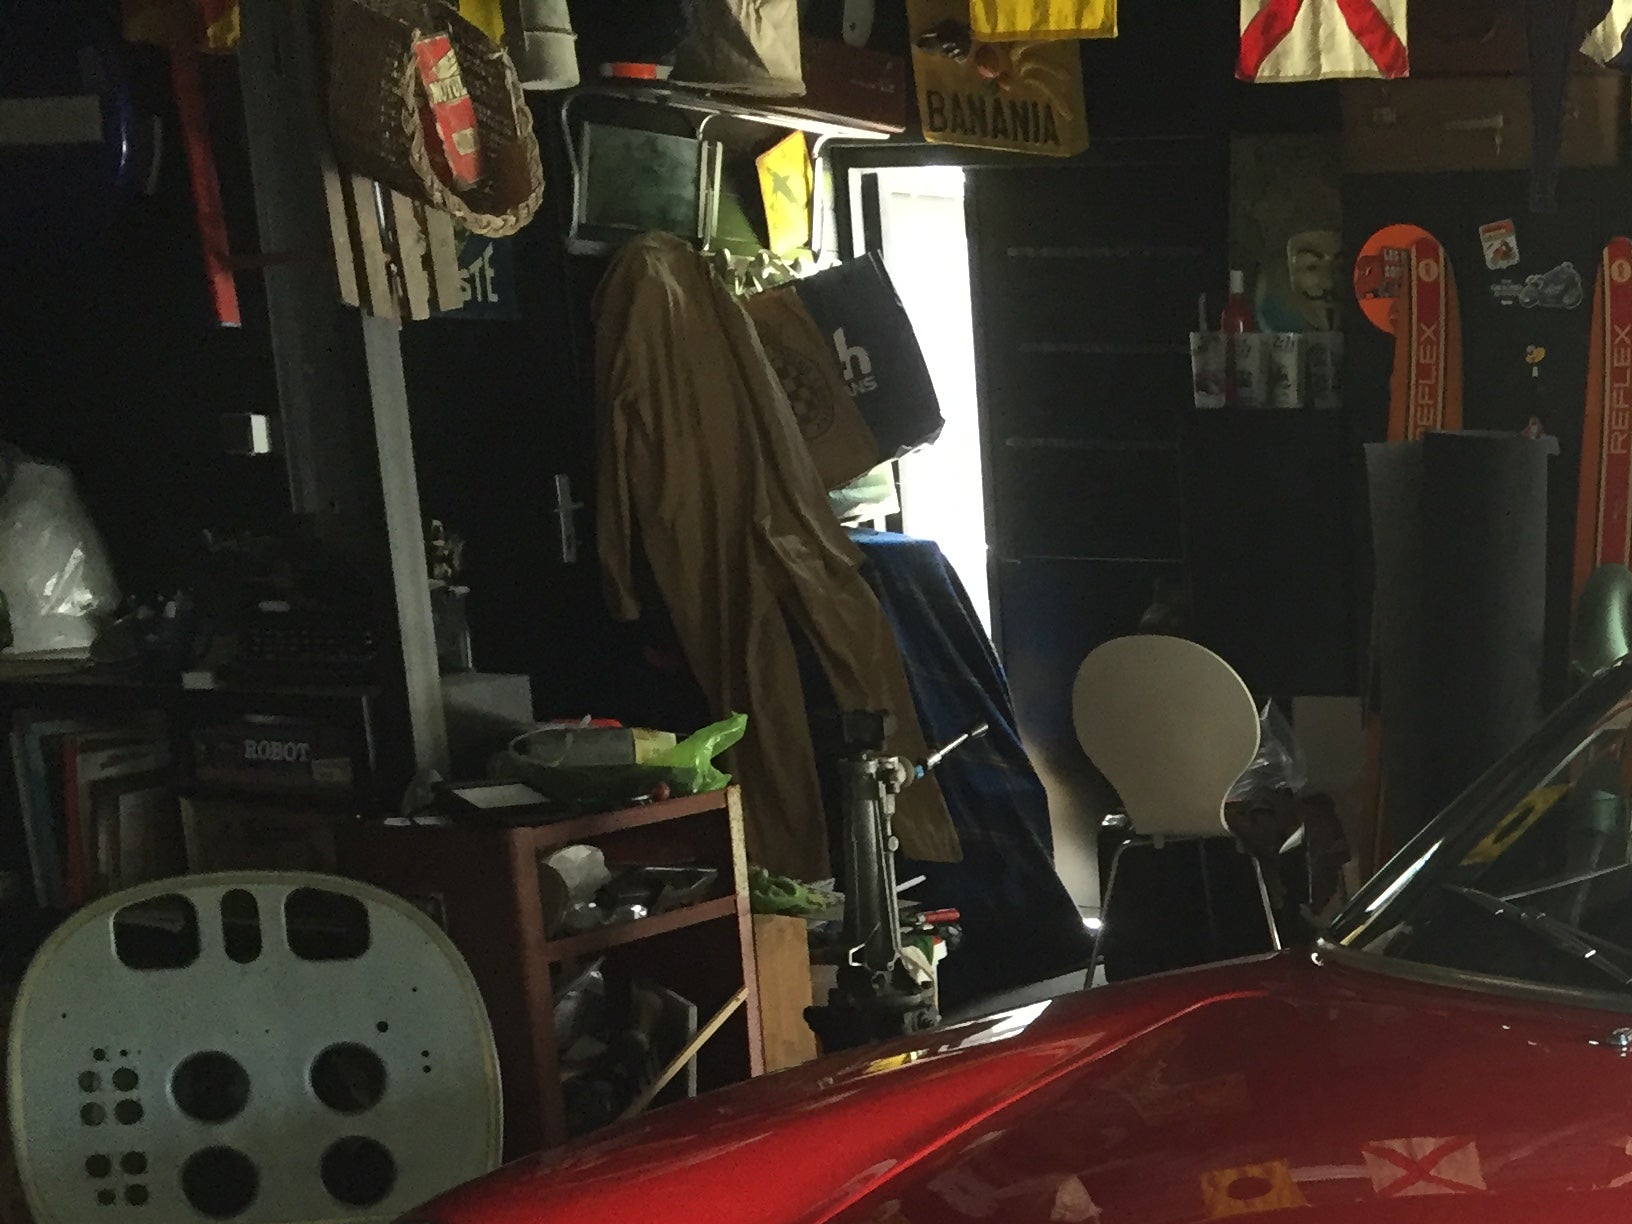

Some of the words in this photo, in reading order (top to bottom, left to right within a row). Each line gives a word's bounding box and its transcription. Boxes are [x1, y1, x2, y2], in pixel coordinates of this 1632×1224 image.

[926, 89, 1060, 146] BANANIA
[1610, 323, 1632, 454] REFLEX
[243, 739, 312, 762] ROBOT
